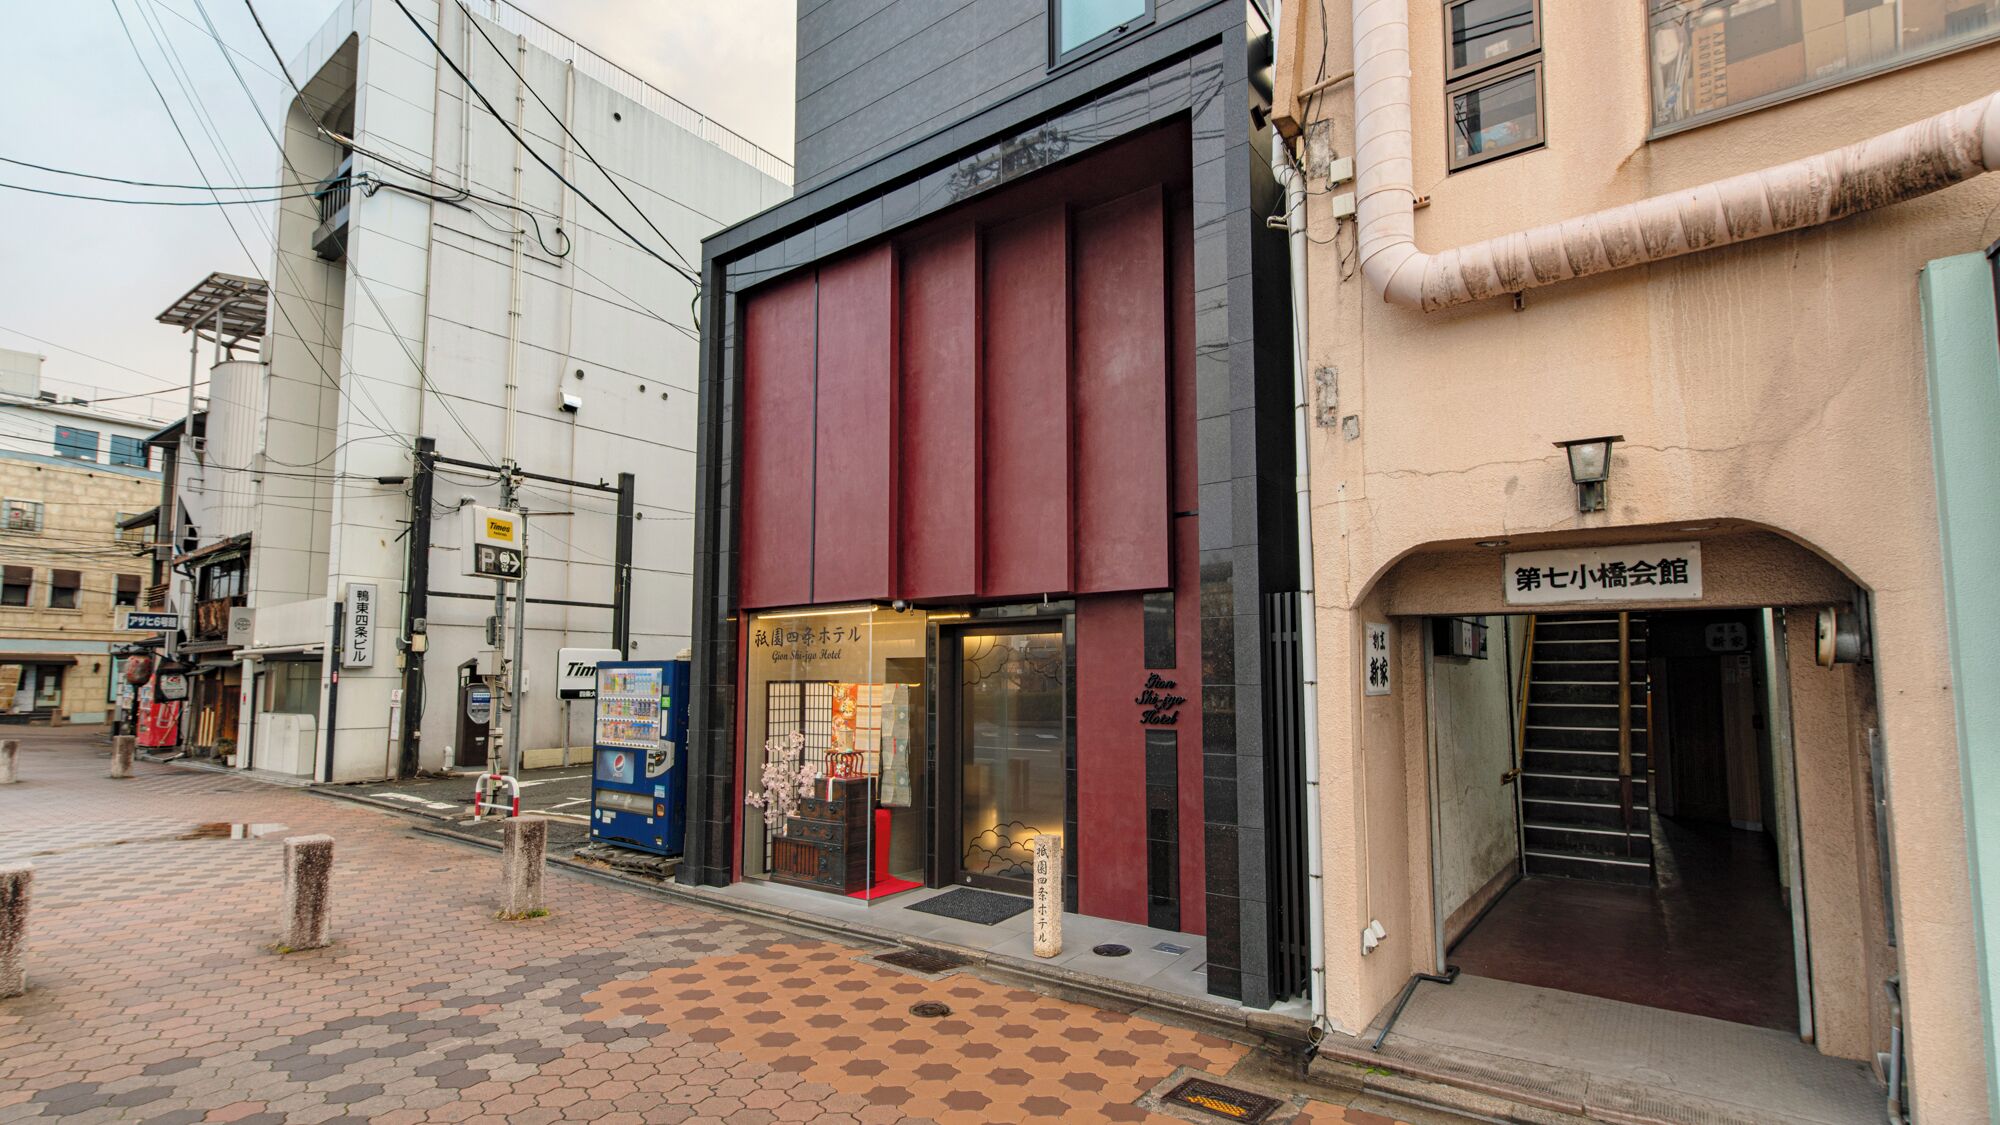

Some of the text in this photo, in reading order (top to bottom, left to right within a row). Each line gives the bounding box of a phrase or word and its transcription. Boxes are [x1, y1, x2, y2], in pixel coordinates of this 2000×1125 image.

[490, 522, 511, 533] Times
[481, 547, 496, 572] P
[1515, 558, 1689, 591] 第七小橋会館
[353, 590, 369, 662] 鴨東四条ビル
[755, 626, 861, 648] 祇園四条ホテル
[772, 650, 788, 663] Gion
[819, 648, 841, 660] Hotel
[567, 662, 596, 677] Tim
[1144, 672, 1177, 689] Gion
[1140, 709, 1179, 725] Hotel
